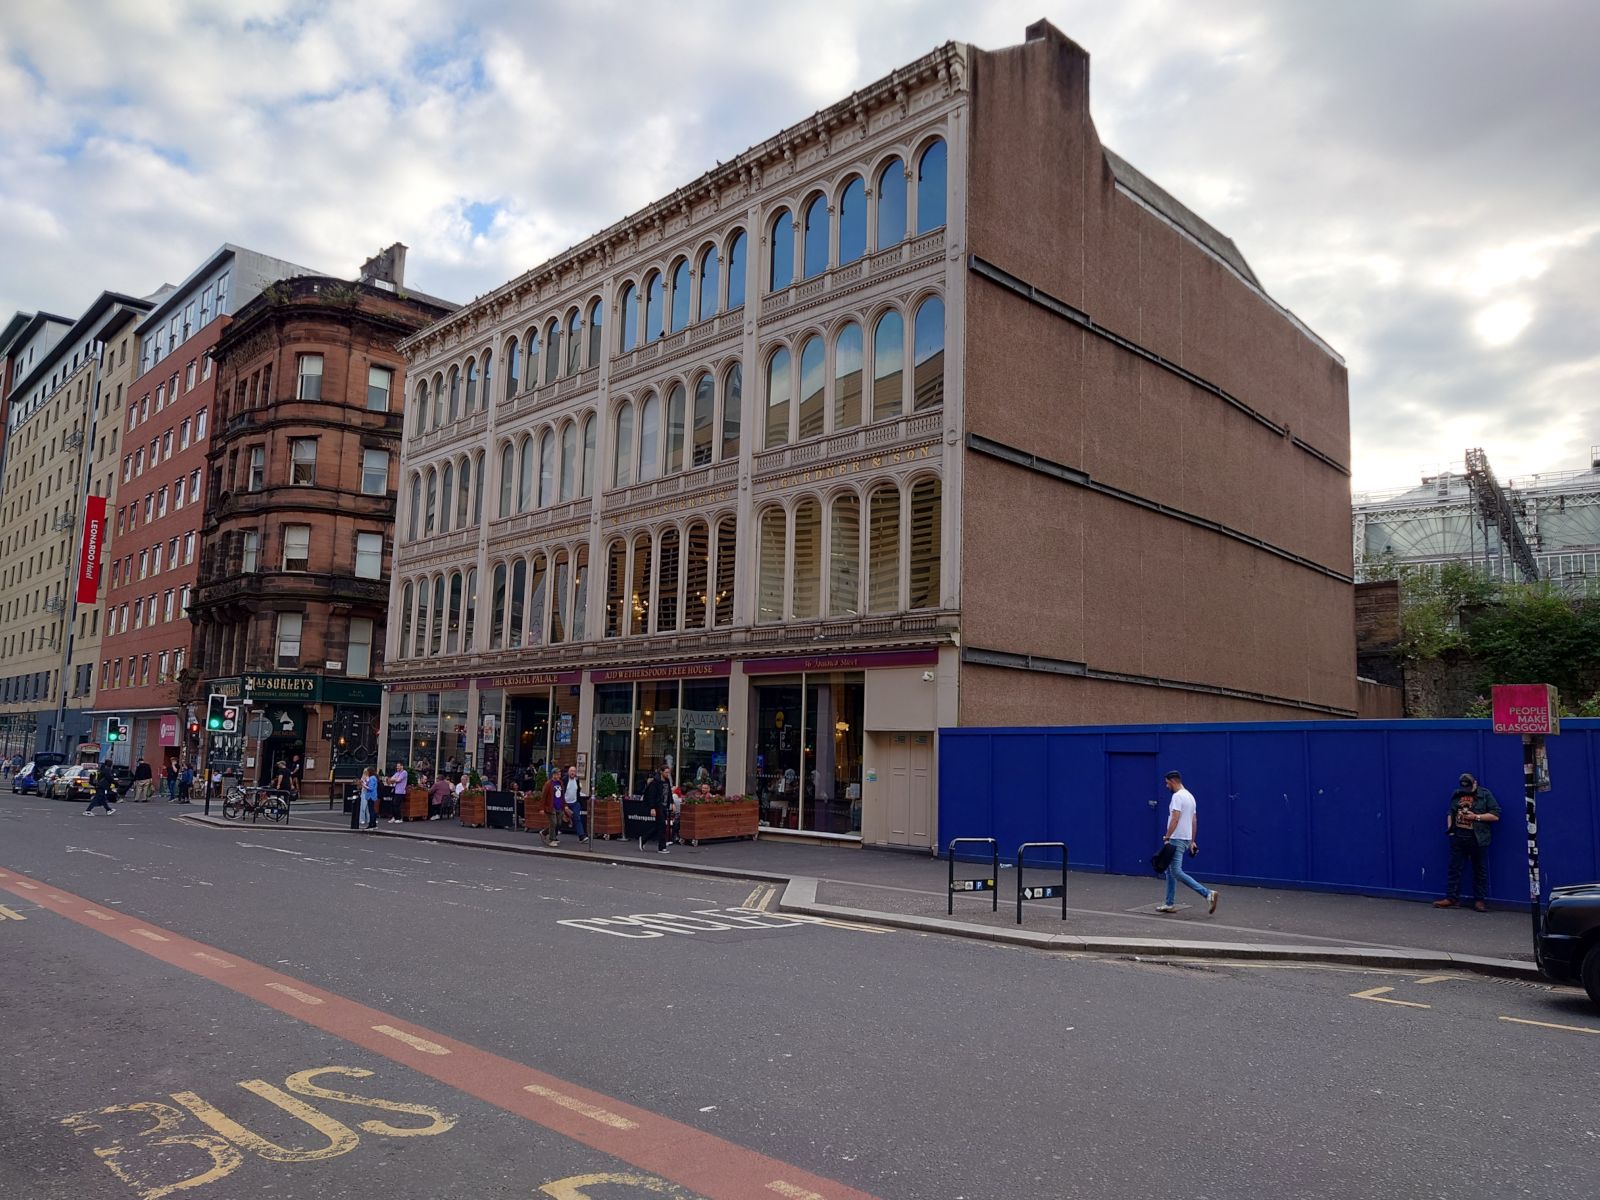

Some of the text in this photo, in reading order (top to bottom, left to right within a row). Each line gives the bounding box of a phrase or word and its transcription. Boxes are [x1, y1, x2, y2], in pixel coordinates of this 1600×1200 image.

[781, 461, 861, 489] GARDNER
[872, 457, 881, 467] &
[85, 519, 99, 580] LEONARDO Hotel
[618, 668, 668, 679] WETHERSPOON
[668, 666, 688, 676] FREE
[688, 664, 713, 674] HOUSE
[492, 674, 558, 687] THE CRYSTAL PALACE
[1509, 706, 1547, 715] PEOPLE
[1517, 715, 1547, 723] MAKE
[1495, 723, 1547, 732] GLASGOW
[61, 1066, 460, 1200] BUS
